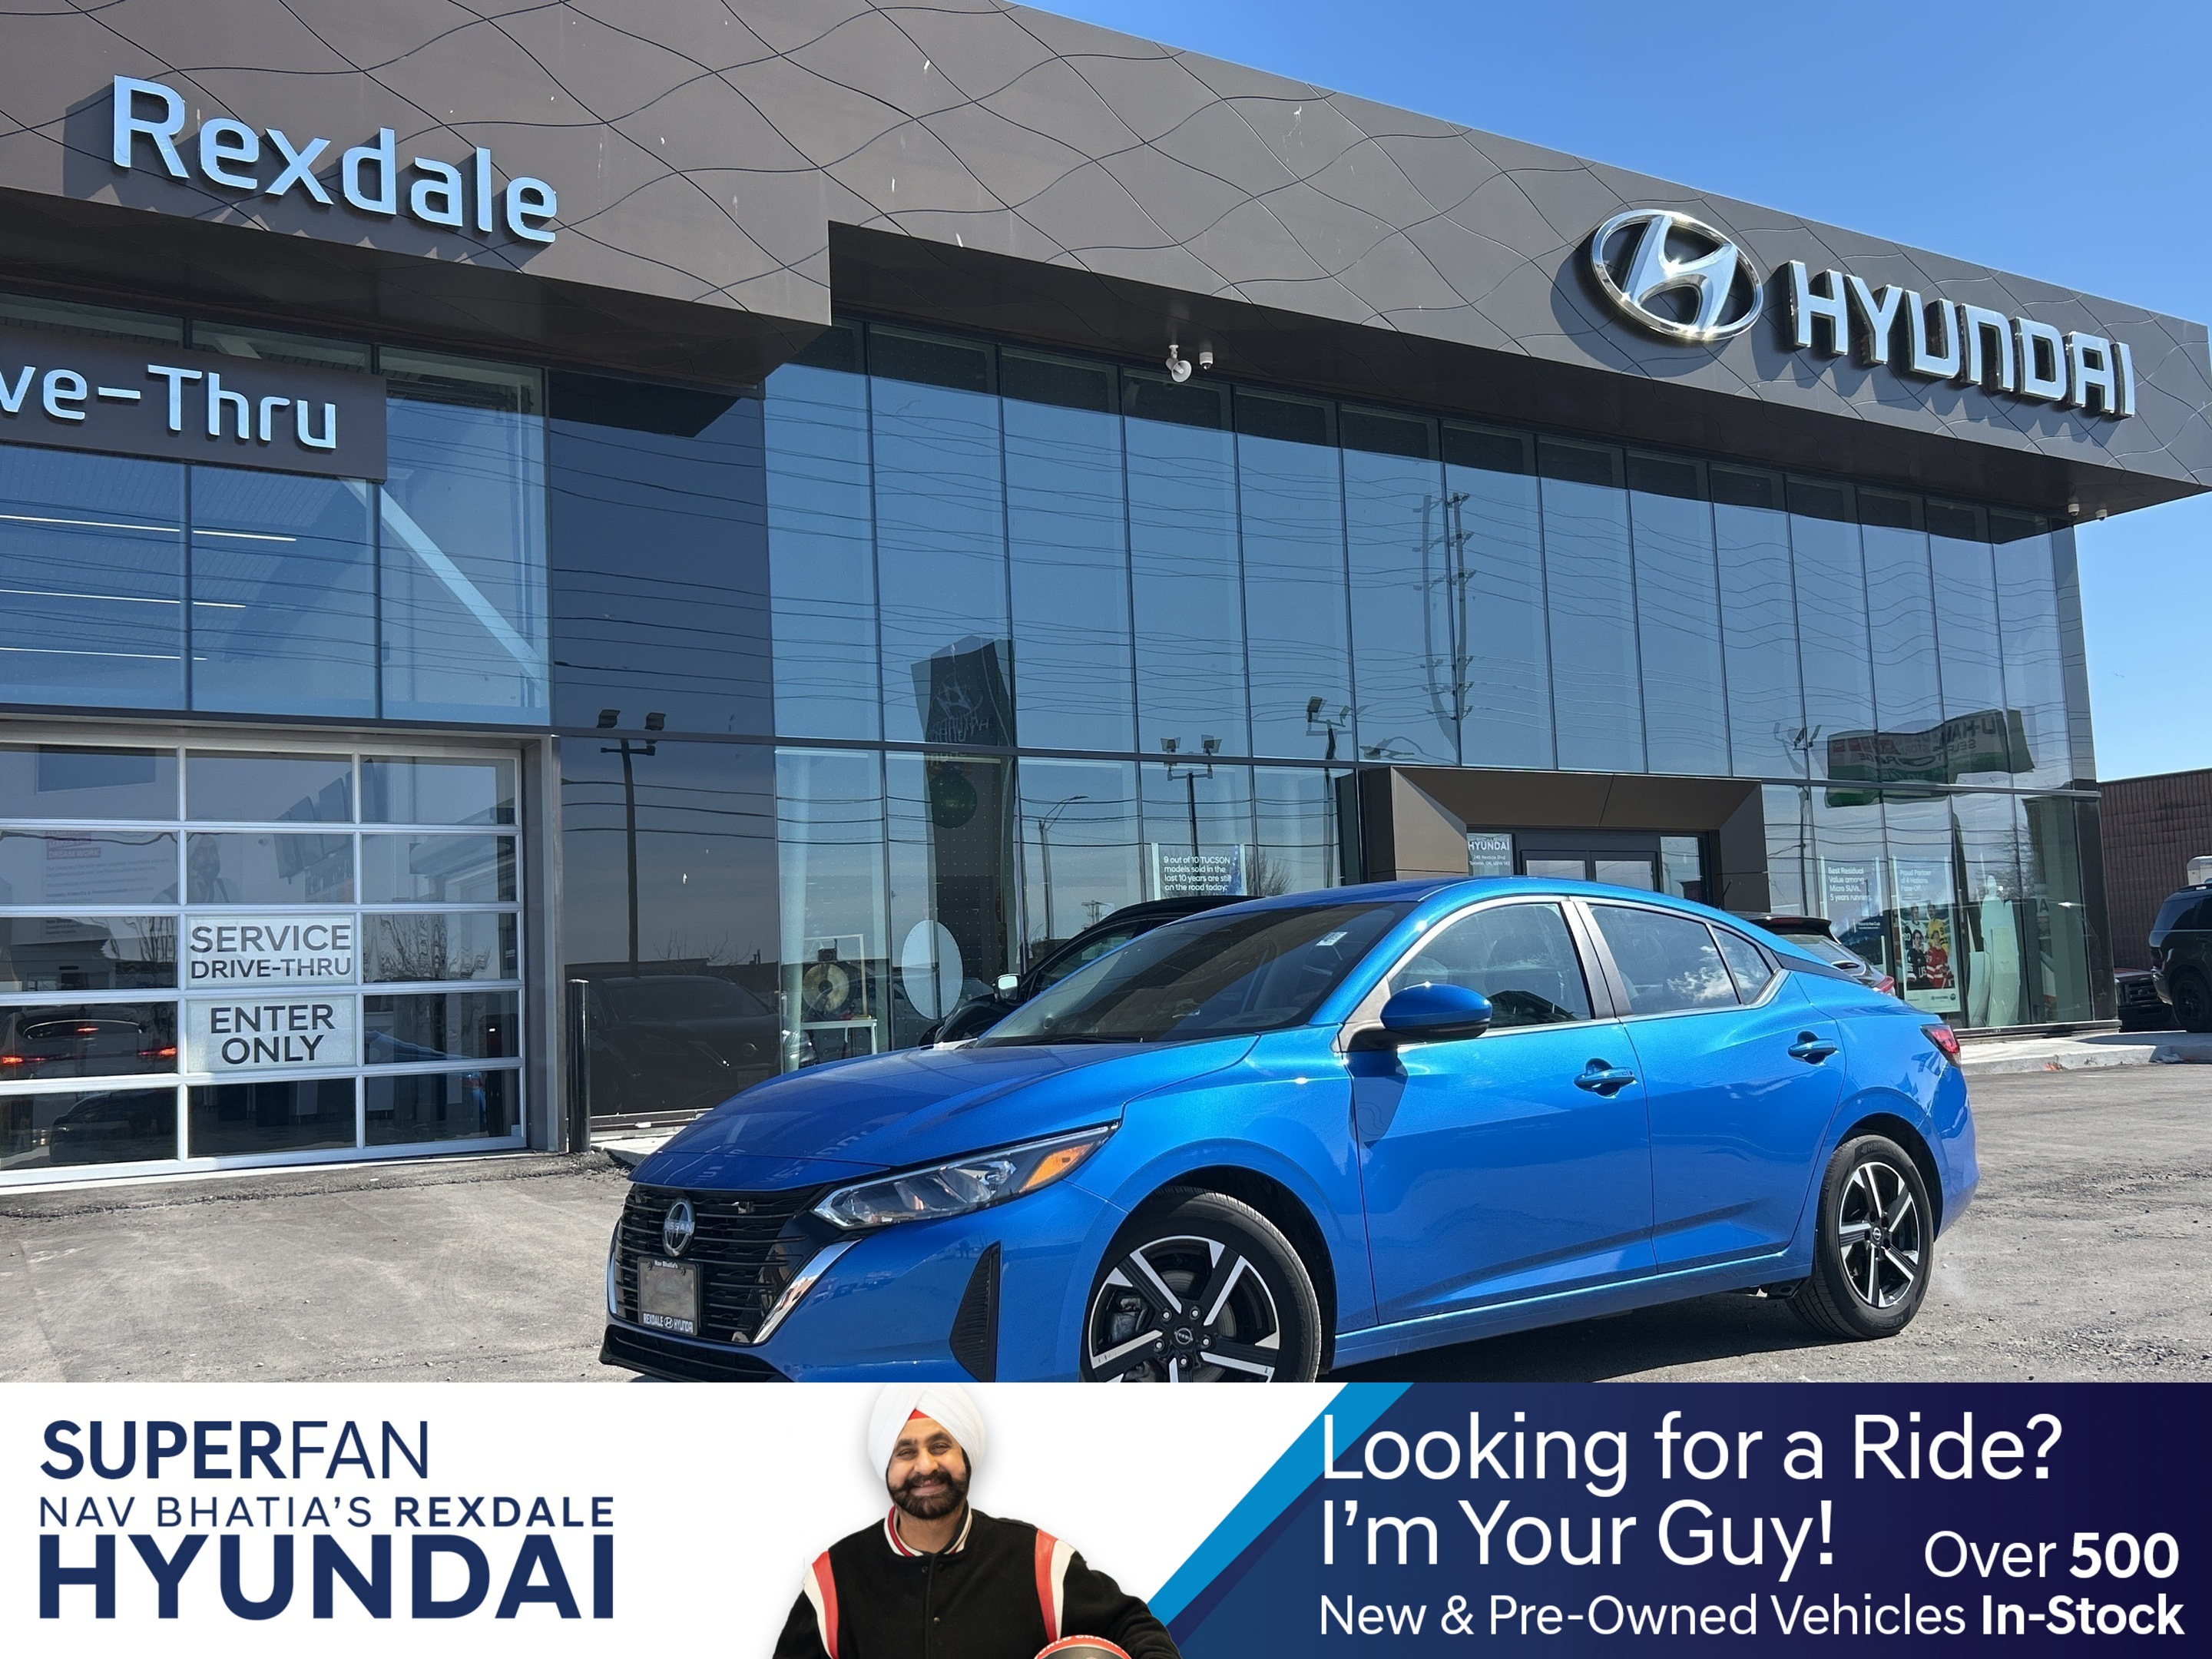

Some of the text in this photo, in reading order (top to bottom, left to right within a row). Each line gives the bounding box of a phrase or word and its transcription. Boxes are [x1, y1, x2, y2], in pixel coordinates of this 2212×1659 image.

[113, 74, 558, 244] Rexdale
[1786, 259, 2136, 419] HYUNDAI
[1468, 841, 1509, 850] HYUNDAI
[1163, 856, 1169, 864] 9
[1183, 856, 1191, 864] of
[1187, 875, 1207, 883] years
[190, 924, 352, 953] SERVICE
[190, 957, 352, 979] DRIVE-THRU
[210, 1004, 336, 1034] ENTER
[221, 1035, 324, 1065] ONLY
[643, 1313, 694, 1333] REXDALE HYUNDAI
